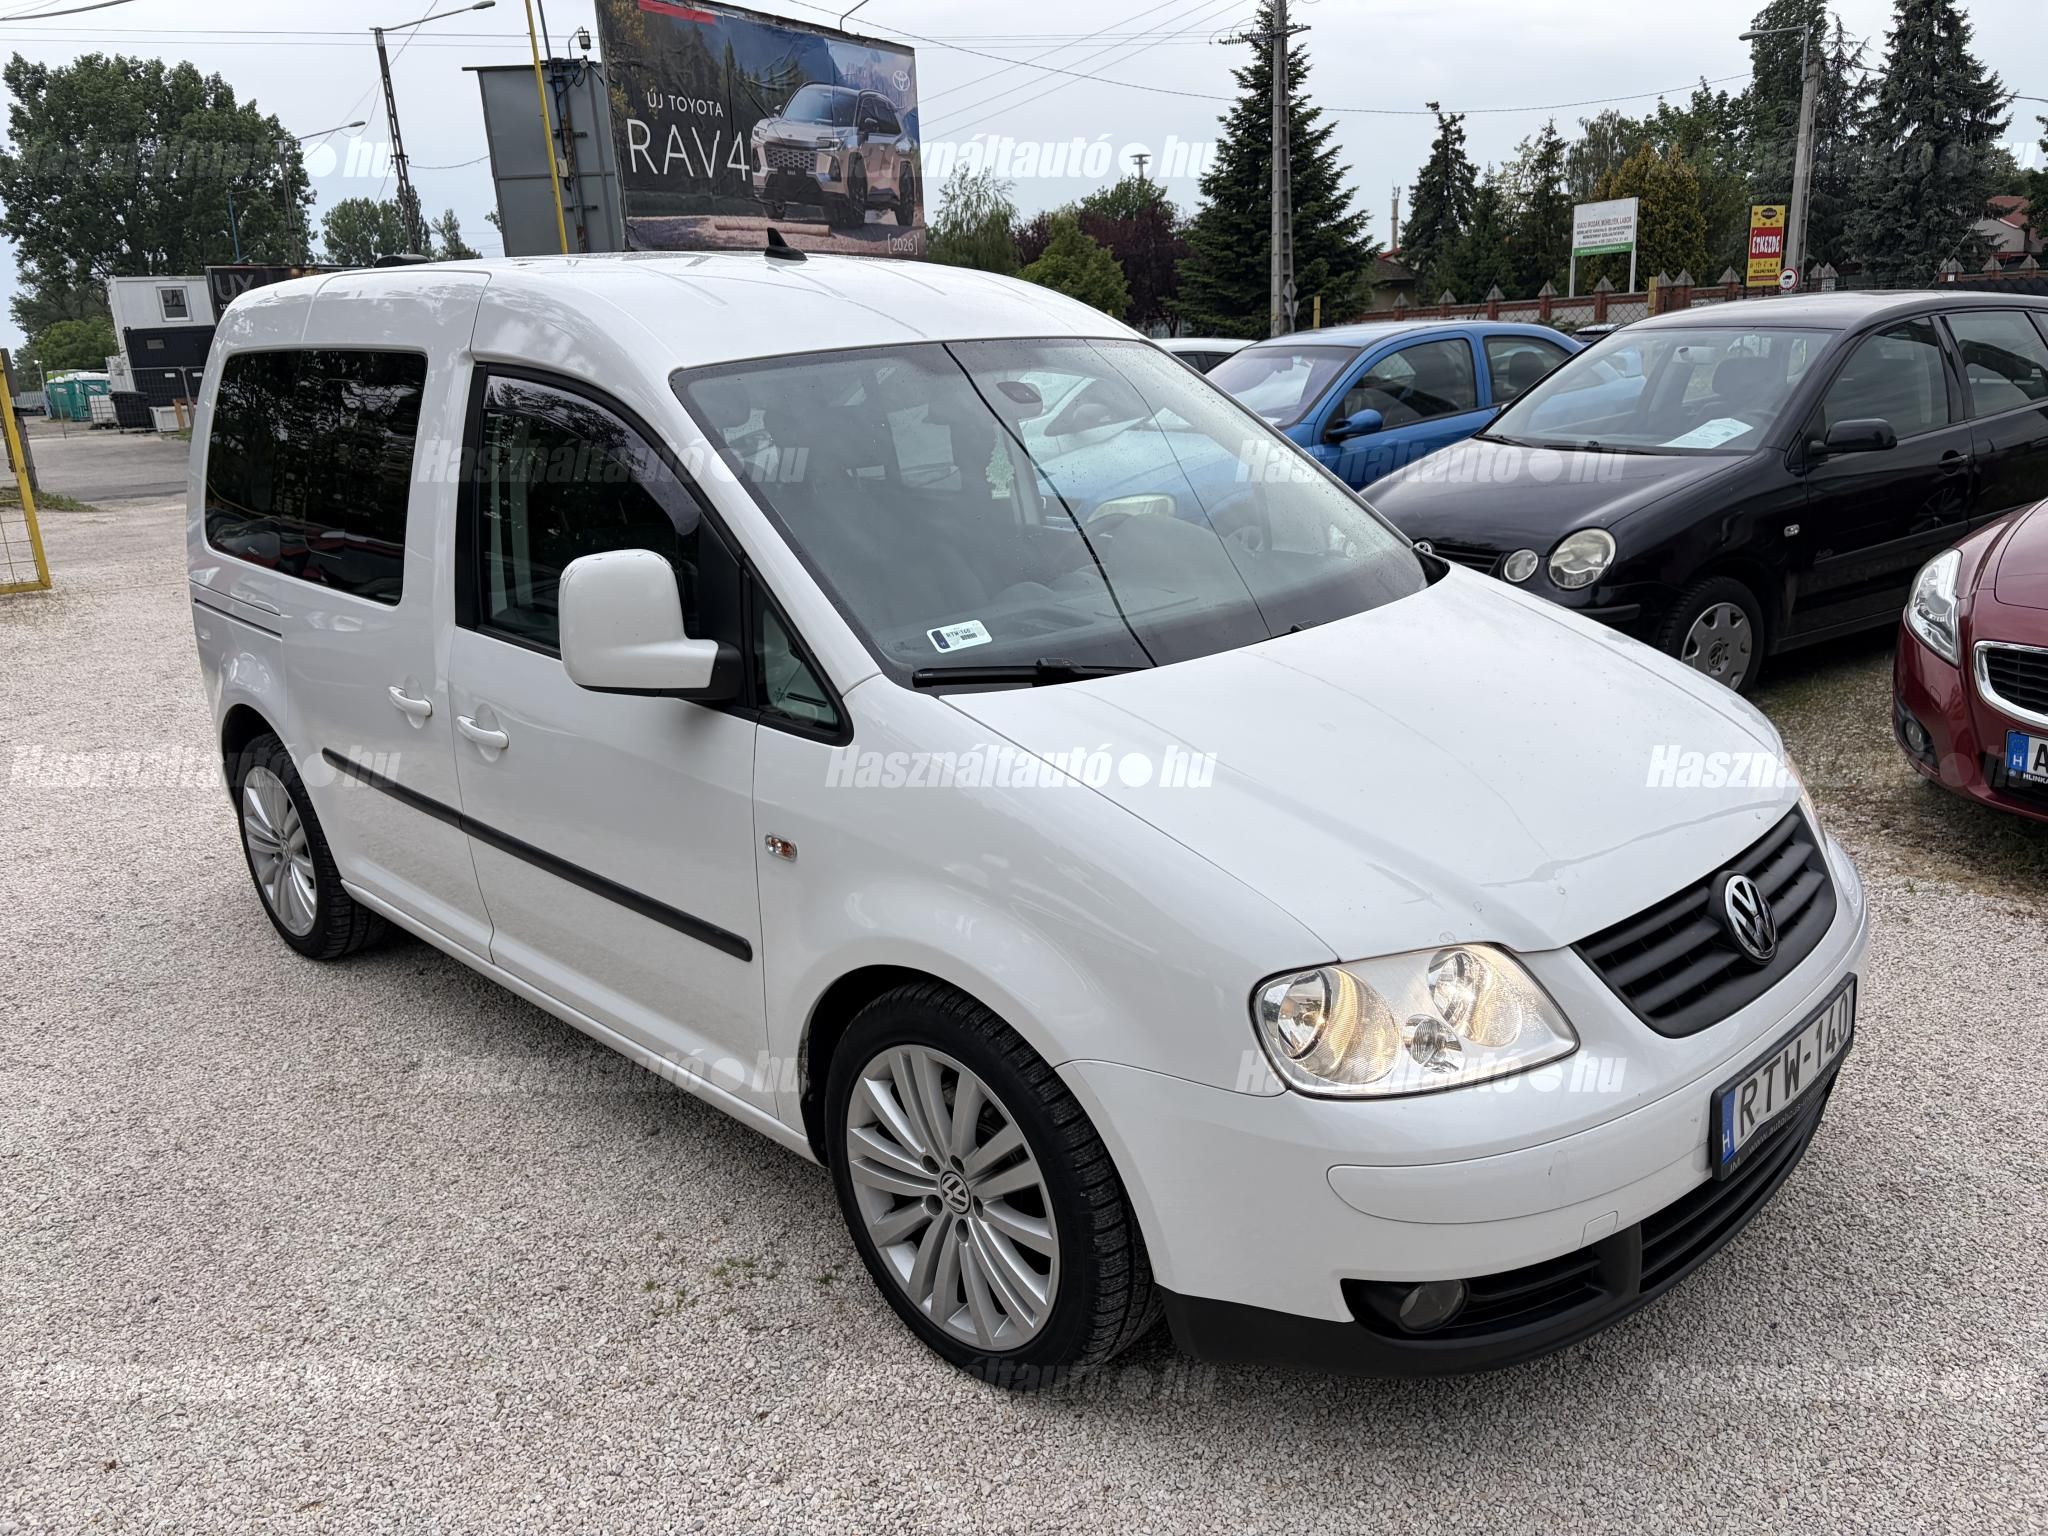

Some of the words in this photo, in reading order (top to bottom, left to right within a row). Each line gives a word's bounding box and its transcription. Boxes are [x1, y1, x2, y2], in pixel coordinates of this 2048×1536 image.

[647, 87, 663, 109] ÚJ
[668, 94, 724, 118] TOYOTA
[1751, 229, 1781, 254] ÉTKEZDE
[1739, 991, 1849, 1138] RTW-140
